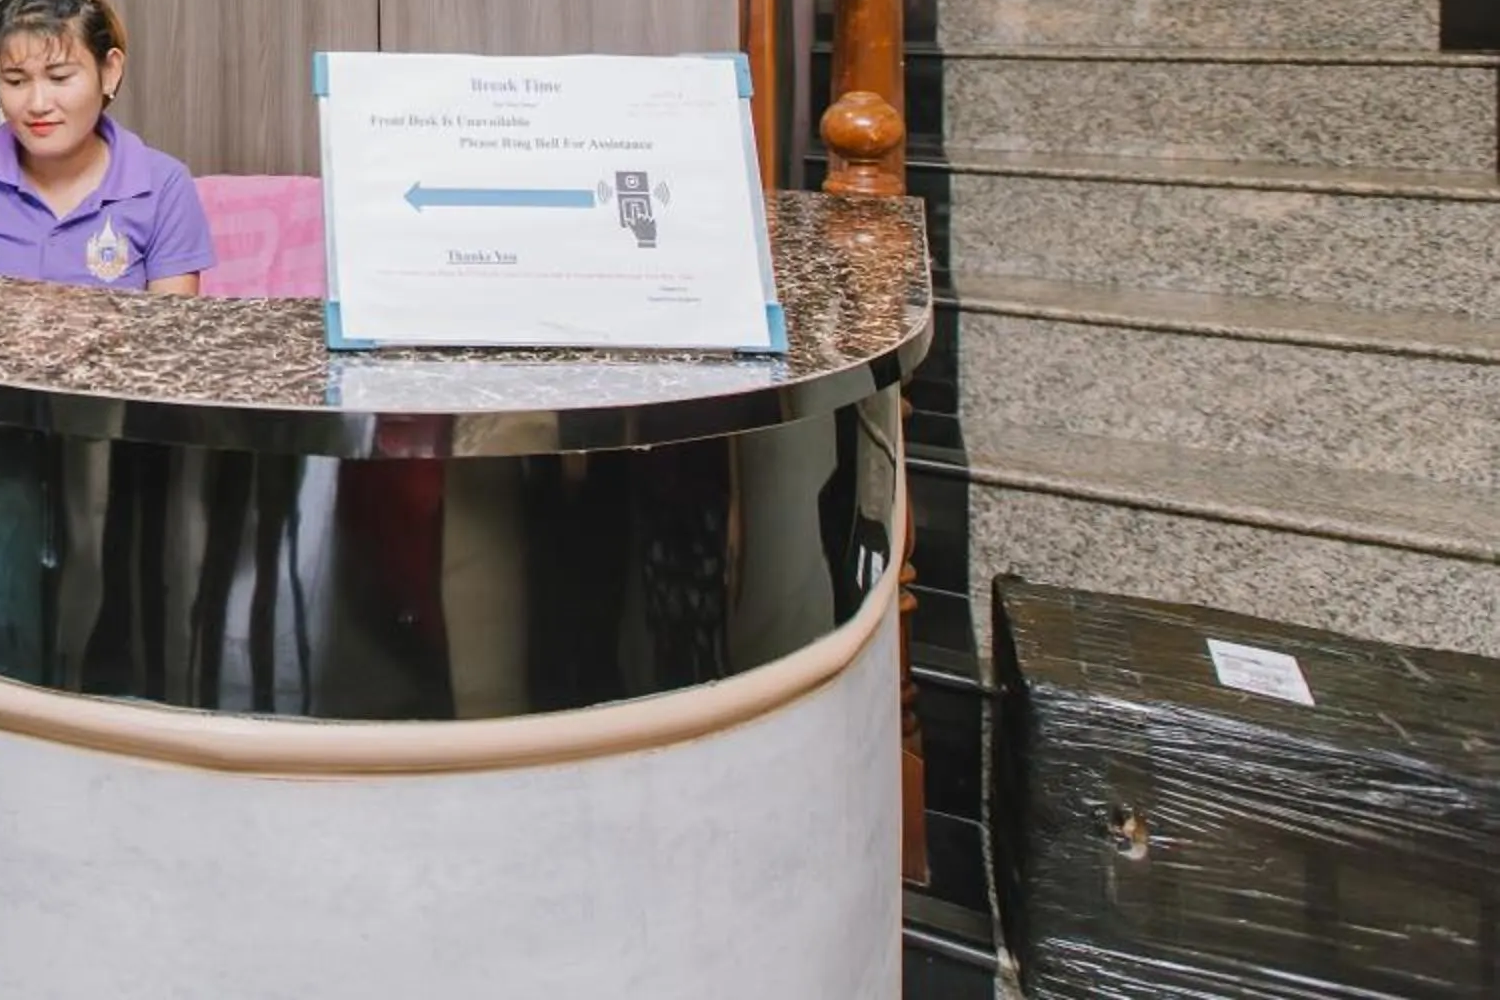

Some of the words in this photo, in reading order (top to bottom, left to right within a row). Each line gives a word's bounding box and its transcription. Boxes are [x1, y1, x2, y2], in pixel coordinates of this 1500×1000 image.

[470, 78, 517, 93] Break
[522, 78, 562, 94] Time
[409, 114, 438, 127] Desk
[501, 137, 532, 151] Ring
[535, 137, 560, 149] Bell
[563, 136, 585, 149] For
